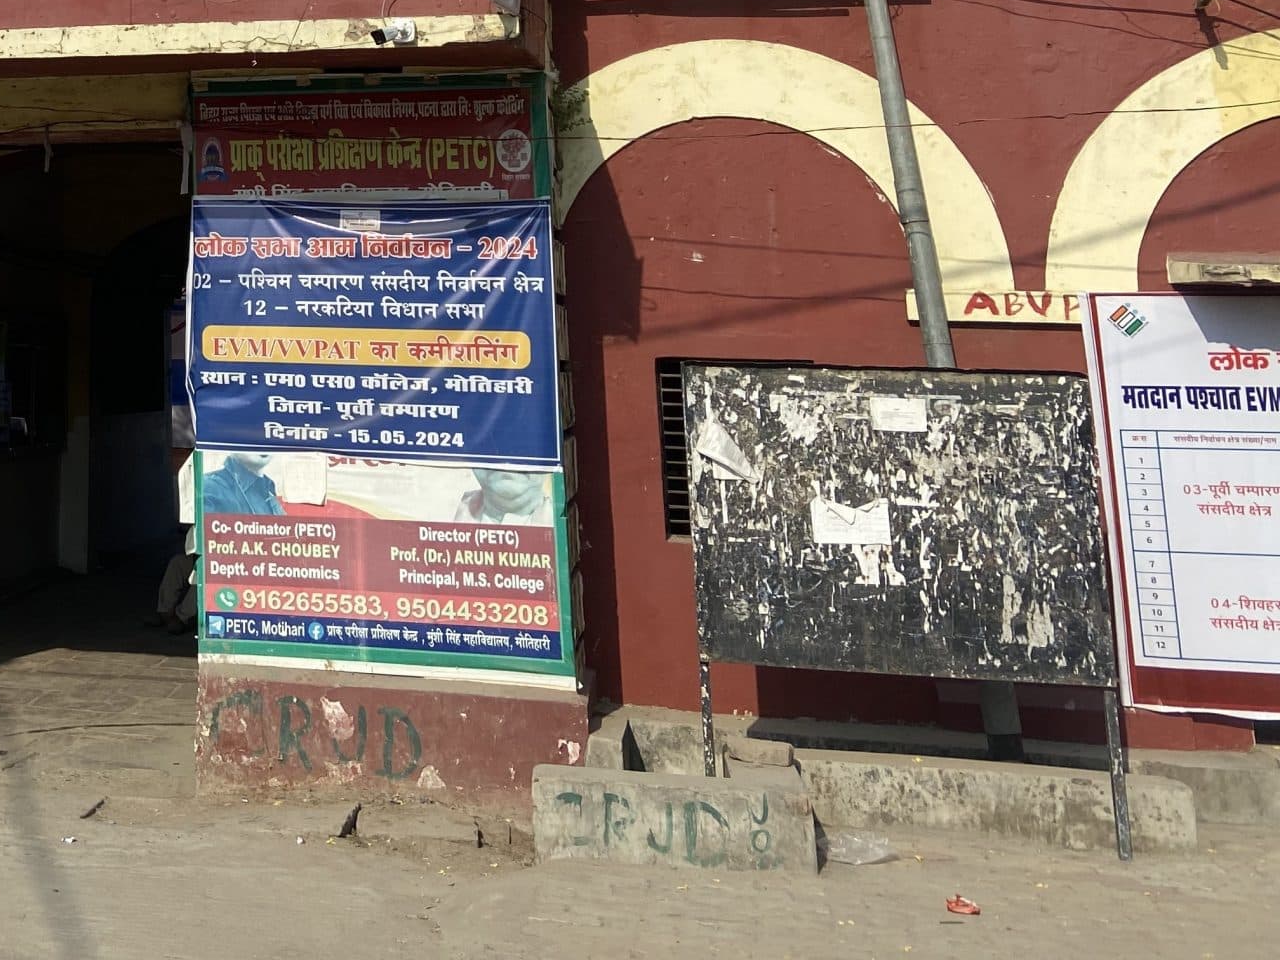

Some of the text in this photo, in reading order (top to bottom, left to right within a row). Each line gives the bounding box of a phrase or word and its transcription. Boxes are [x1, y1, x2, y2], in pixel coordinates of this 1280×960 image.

[425, 136, 495, 179] (PETC)
[195, 231, 537, 260] लोक सभा आम निर्वाचन 2024
[240, 269, 290, 290] पश्चिम
[299, 274, 363, 291] चम्पारण
[371, 269, 429, 293] संसदीय
[437, 268, 504, 293] निर्वाचन
[513, 269, 544, 294] क्षेत्र
[244, 297, 485, 320] 12 नरकटिया विधान सभा
[964, 290, 1080, 321] ABVP
[212, 335, 519, 363] EVM/VVPAT का कमीशनिंग
[1208, 344, 1270, 370] लोक
[200, 371, 246, 386] स्थान
[444, 374, 533, 394] मोतिहारी
[336, 397, 374, 420] पूर्वी
[380, 402, 460, 419] चम्पारण
[1121, 385, 1181, 409] मतदान
[1185, 386, 1241, 410] पश्चात
[264, 422, 465, 447] दिनांक 15.05.2024
[234, 521, 291, 537] Ordinator
[295, 523, 336, 541] (PETC)
[420, 526, 519, 549] Director (PETC)
[209, 540, 340, 559] Prof. A.K. CHOUBEY
[391, 547, 551, 570] Prof. (Dr.) ARUN KUMAR
[210, 561, 340, 581] Deptt. of Economics
[399, 569, 545, 593] Principal, M.S. College
[243, 589, 548, 626] 9162655583, 9504433208
[226, 620, 305, 637] PETC, Motihari
[345, 625, 368, 639] परीक्षा
[371, 625, 400, 641] प्रशिक्षण
[427, 630, 443, 648] मुंशी
[446, 631, 460, 645] सिंह
[516, 635, 550, 652] मोतिहारी
